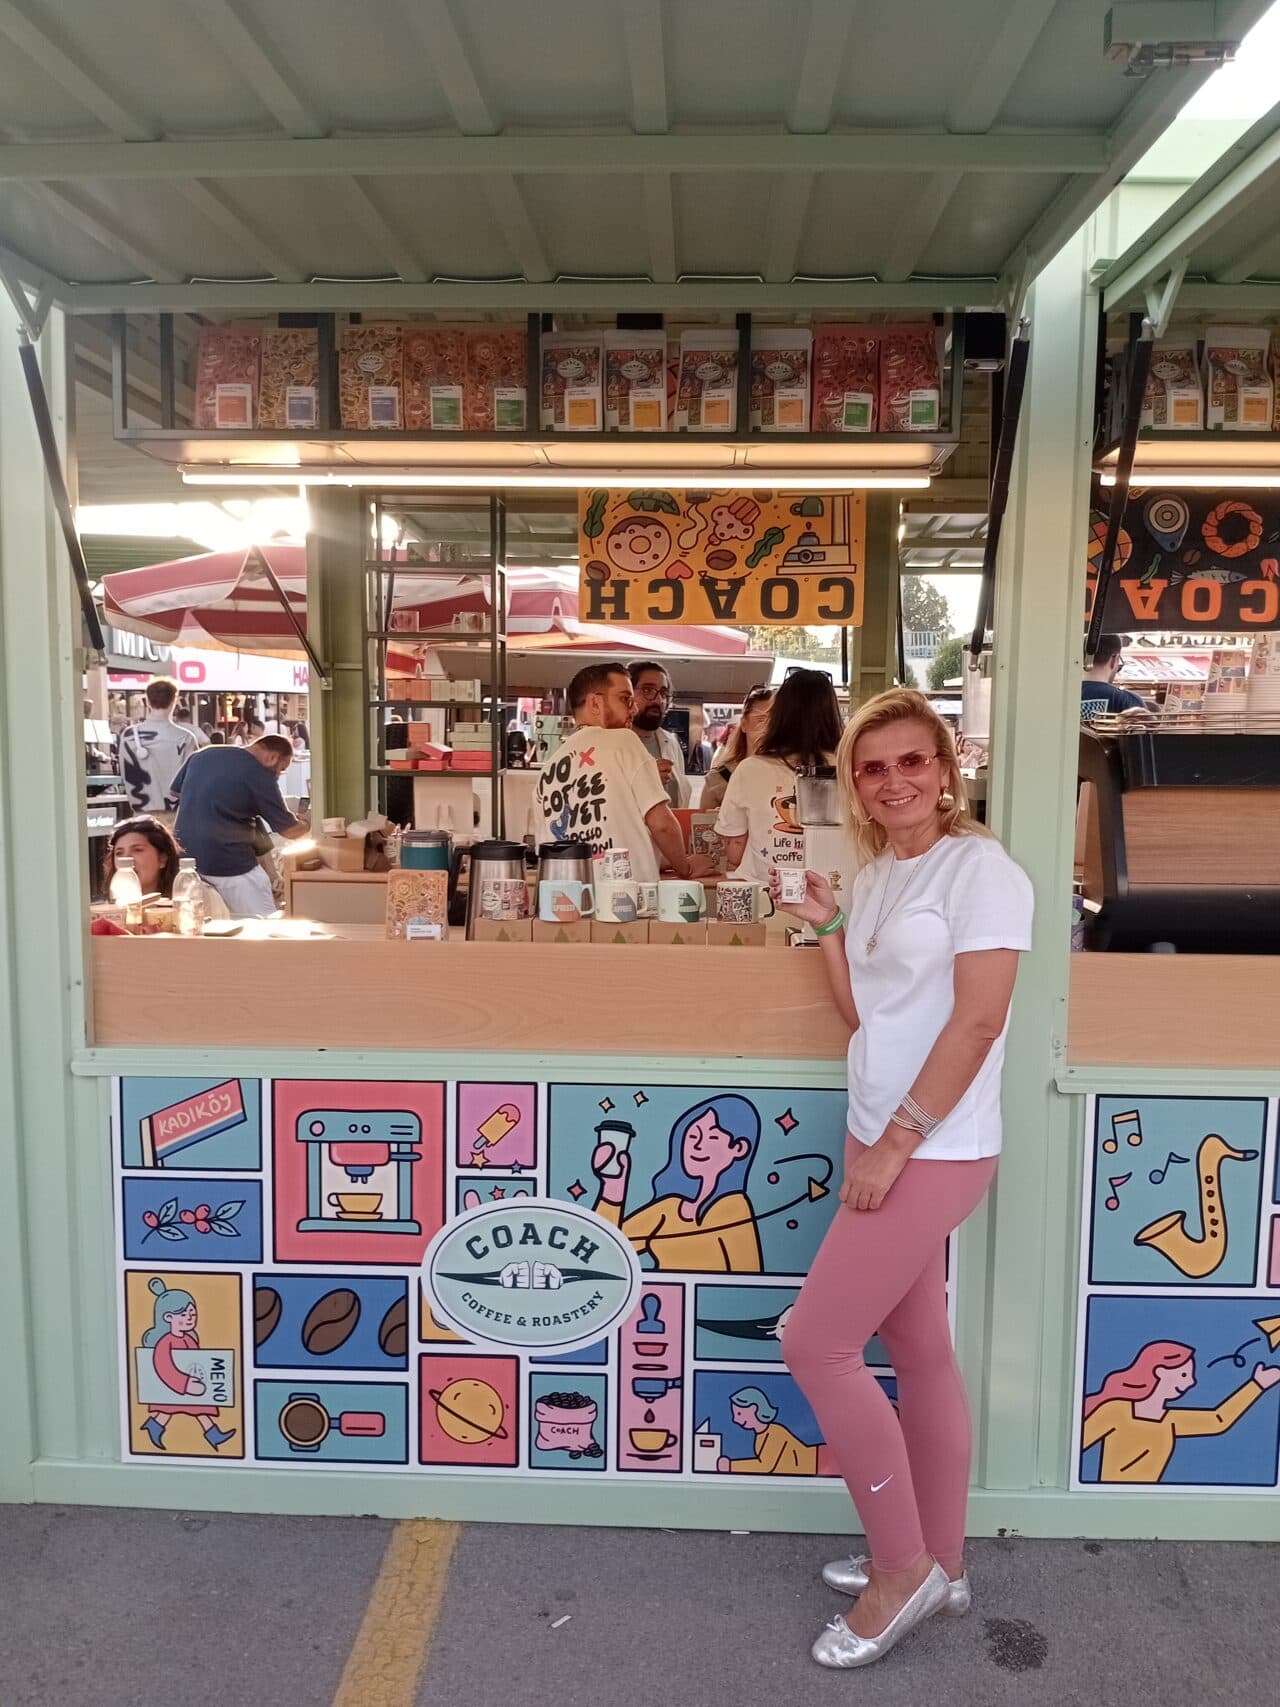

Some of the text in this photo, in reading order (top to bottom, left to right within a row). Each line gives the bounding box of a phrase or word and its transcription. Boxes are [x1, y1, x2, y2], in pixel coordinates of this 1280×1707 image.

[585, 576, 856, 621] COACH
[539, 755, 571, 796] NO
[773, 837, 792, 848] Life
[465, 1222, 600, 1264] COACH
[461, 1290, 604, 1327] COFFEE & ROASTERY
[550, 1426, 579, 1435] COACH
